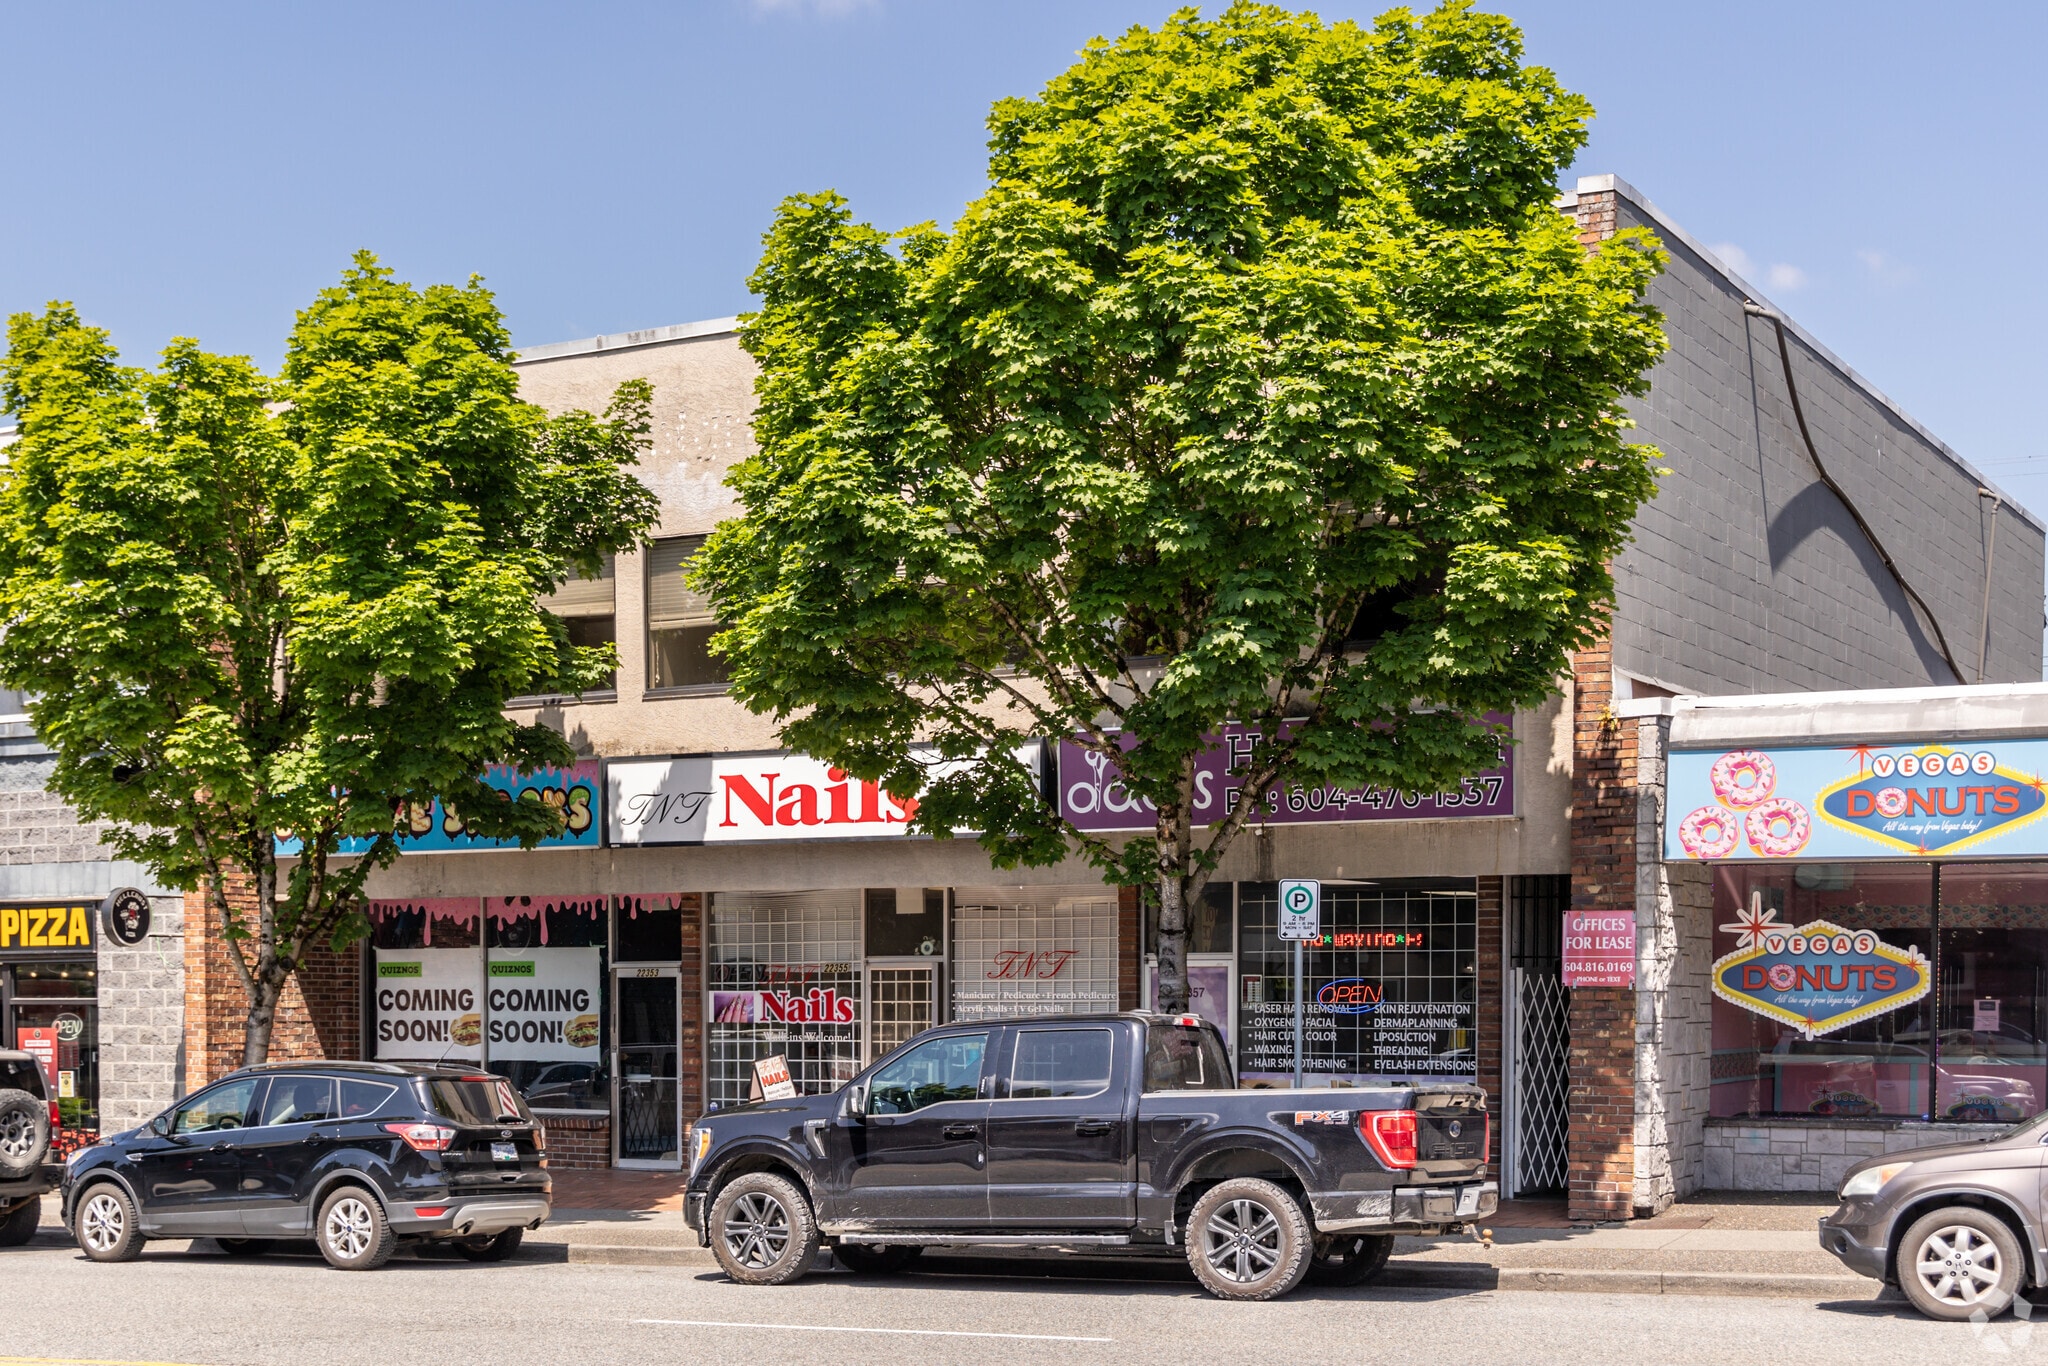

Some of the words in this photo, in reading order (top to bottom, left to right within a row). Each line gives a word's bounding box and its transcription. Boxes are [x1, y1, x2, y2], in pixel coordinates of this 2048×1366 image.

[1875, 754, 1991, 775] VEGAS
[621, 791, 717, 826] TNT
[719, 766, 920, 827] Nails
[1847, 785, 2020, 818] DONUTS
[1882, 821, 1898, 832] All
[1898, 822, 1909, 831] the
[1910, 825, 1924, 835] way
[1923, 821, 1940, 834] from
[1941, 820, 1959, 834] Vegas
[1960, 819, 1982, 834] baby!
[1294, 893, 1306, 908] P
[0, 907, 91, 948] PIZZA
[1572, 918, 1626, 931] OFFICES
[1565, 936, 1592, 949] FOR
[1595, 936, 1632, 949] LEASE
[1768, 937, 1871, 952] VEGAS
[380, 965, 419, 975] QUIZNOS
[491, 965, 532, 974] QUIZNOS
[823, 964, 849, 973] 22355
[987, 950, 1080, 979] TNT
[1563, 962, 1633, 972] 604.816.0169
[636, 968, 660, 977] 22353
[1742, 963, 1897, 992] DONUTS
[378, 989, 474, 1011] COMING
[957, 992, 995, 1000] Manicure
[1003, 992, 1040, 1000] Pedicure
[1047, 992, 1077, 1000] French
[1078, 992, 1116, 1000] Pedicure
[1320, 984, 1382, 1003] OPEN
[489, 989, 589, 1012] COMING
[759, 988, 853, 1024] Nails
[1774, 994, 1789, 1003] All
[1788, 995, 1798, 1003] the
[1798, 998, 1811, 1007] way
[1811, 995, 1827, 1007] from
[1827, 994, 1843, 1007] Vegas
[1844, 995, 1863, 1007] baby!
[957, 1005, 986, 1014] Acrylic
[1255, 1004, 1282, 1013] LASER
[1283, 1004, 1306, 1014] HAR
[1307, 1004, 1350, 1014] REMOVAL
[1374, 1005, 1396, 1014] SKIN
[1398, 1005, 1471, 1014] REJUVENATION
[53, 1020, 80, 1034] OPEN
[1254, 1018, 1304, 1028] OXYGENE
[1306, 1018, 1337, 1027] FACIAL
[1374, 1019, 1458, 1028] DERMAPLANNING
[378, 1019, 449, 1042] SOON!
[489, 1020, 564, 1043] SOON!
[762, 1031, 802, 1041] Walk-ins
[805, 1031, 851, 1042] Welcome!
[1254, 1031, 1276, 1041] HAIR
[1278, 1031, 1295, 1041] CUT
[1306, 1032, 1337, 1041] COLOR
[1374, 1032, 1436, 1041] LIPOSUCTION
[1254, 1045, 1292, 1054] WAXING
[1373, 1046, 1428, 1055] THREADING
[1254, 1058, 1276, 1068] HAIR
[1374, 1060, 1415, 1069] EYELASH
[1417, 1061, 1476, 1070] EXTENSIONS
[761, 1070, 790, 1087] NAILS
[1295, 1110, 1349, 1125] FX4
